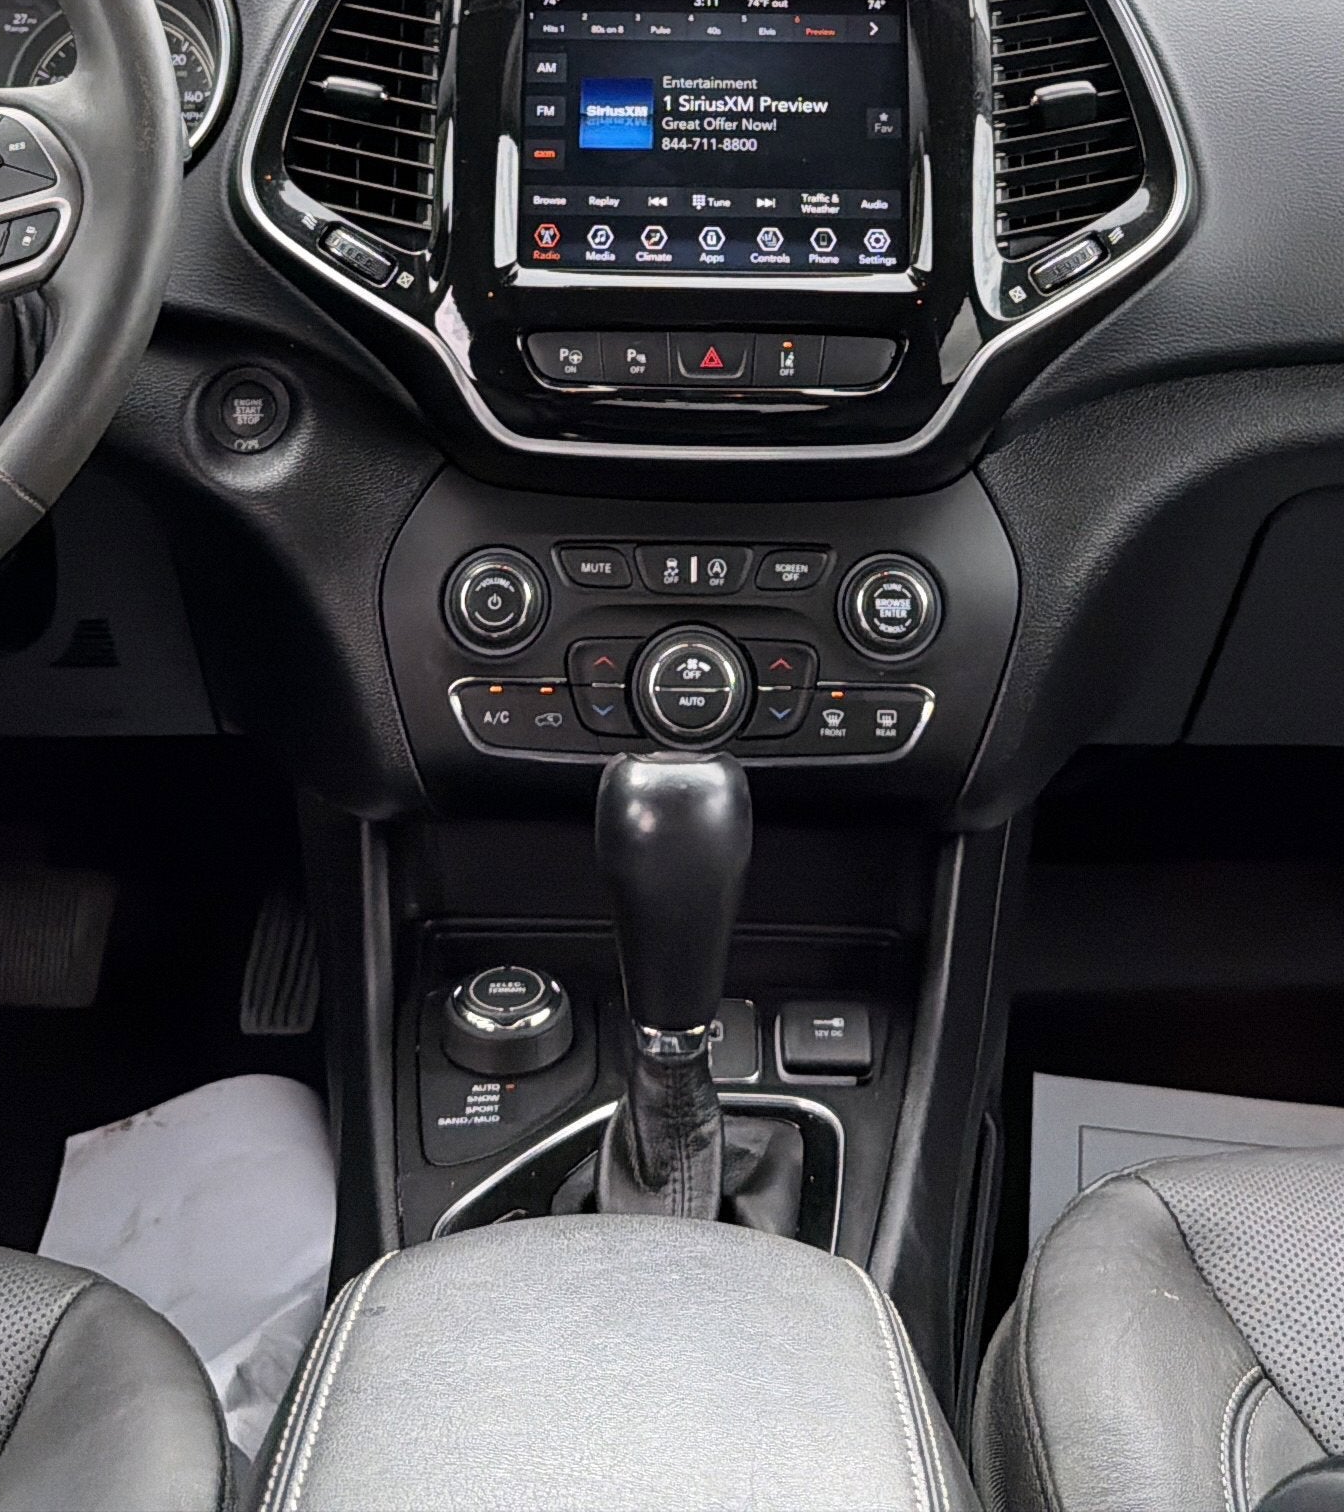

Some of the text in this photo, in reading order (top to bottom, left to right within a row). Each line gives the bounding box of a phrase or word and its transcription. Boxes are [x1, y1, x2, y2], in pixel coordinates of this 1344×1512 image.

[771, 0, 789, 8] out
[650, 26, 671, 35] Pulse
[805, 27, 836, 37] Preview
[536, 62, 557, 73] AM
[662, 75, 758, 90] Entertainment
[663, 94, 829, 114] 1 SiriusXM Preview
[536, 105, 555, 117] FM
[586, 104, 648, 118] SiriusXM
[661, 117, 778, 131] Great Offer Now!
[874, 123, 894, 134] Fav
[8, 142, 26, 152] RES
[661, 137, 758, 152] 844-711-8800
[532, 196, 567, 206] Browse
[588, 196, 620, 208] Replay
[708, 197, 732, 207] Tune
[801, 193, 840, 204] Traffic &
[800, 204, 840, 214] Weather
[860, 199, 889, 210] Audio
[532, 250, 561, 260] Radio
[585, 251, 616, 262] Media
[635, 251, 673, 262] Climate
[699, 253, 725, 264] Apps
[750, 253, 791, 264] Controls
[808, 253, 840, 264] Phone
[858, 254, 897, 266] Settings
[564, 365, 577, 374] ON
[630, 365, 645, 374] OFF
[779, 368, 795, 376] OFF
[233, 398, 263, 407] ENGINE
[236, 406, 262, 414] START
[237, 416, 260, 425] STOP
[581, 562, 612, 573] MUTE
[775, 563, 809, 573] SCREEN
[481, 578, 511, 587] VOLUME
[663, 576, 679, 584] OFF
[709, 578, 725, 586] OFF
[782, 573, 799, 582] OFF
[875, 599, 911, 608] BROWSE
[880, 610, 907, 618] ENTER
[683, 670, 702, 680] OFF
[679, 697, 705, 707] AUTO
[483, 710, 510, 725] A/C
[820, 728, 846, 737] FRONT
[875, 728, 896, 737] REAR
[814, 1029, 844, 1038] 12V DC
[471, 1083, 501, 1093] AUTO
[466, 1094, 500, 1103] SNOW
[465, 1105, 500, 1114] SPORT
[437, 1115, 501, 1126] SAND/MUD
